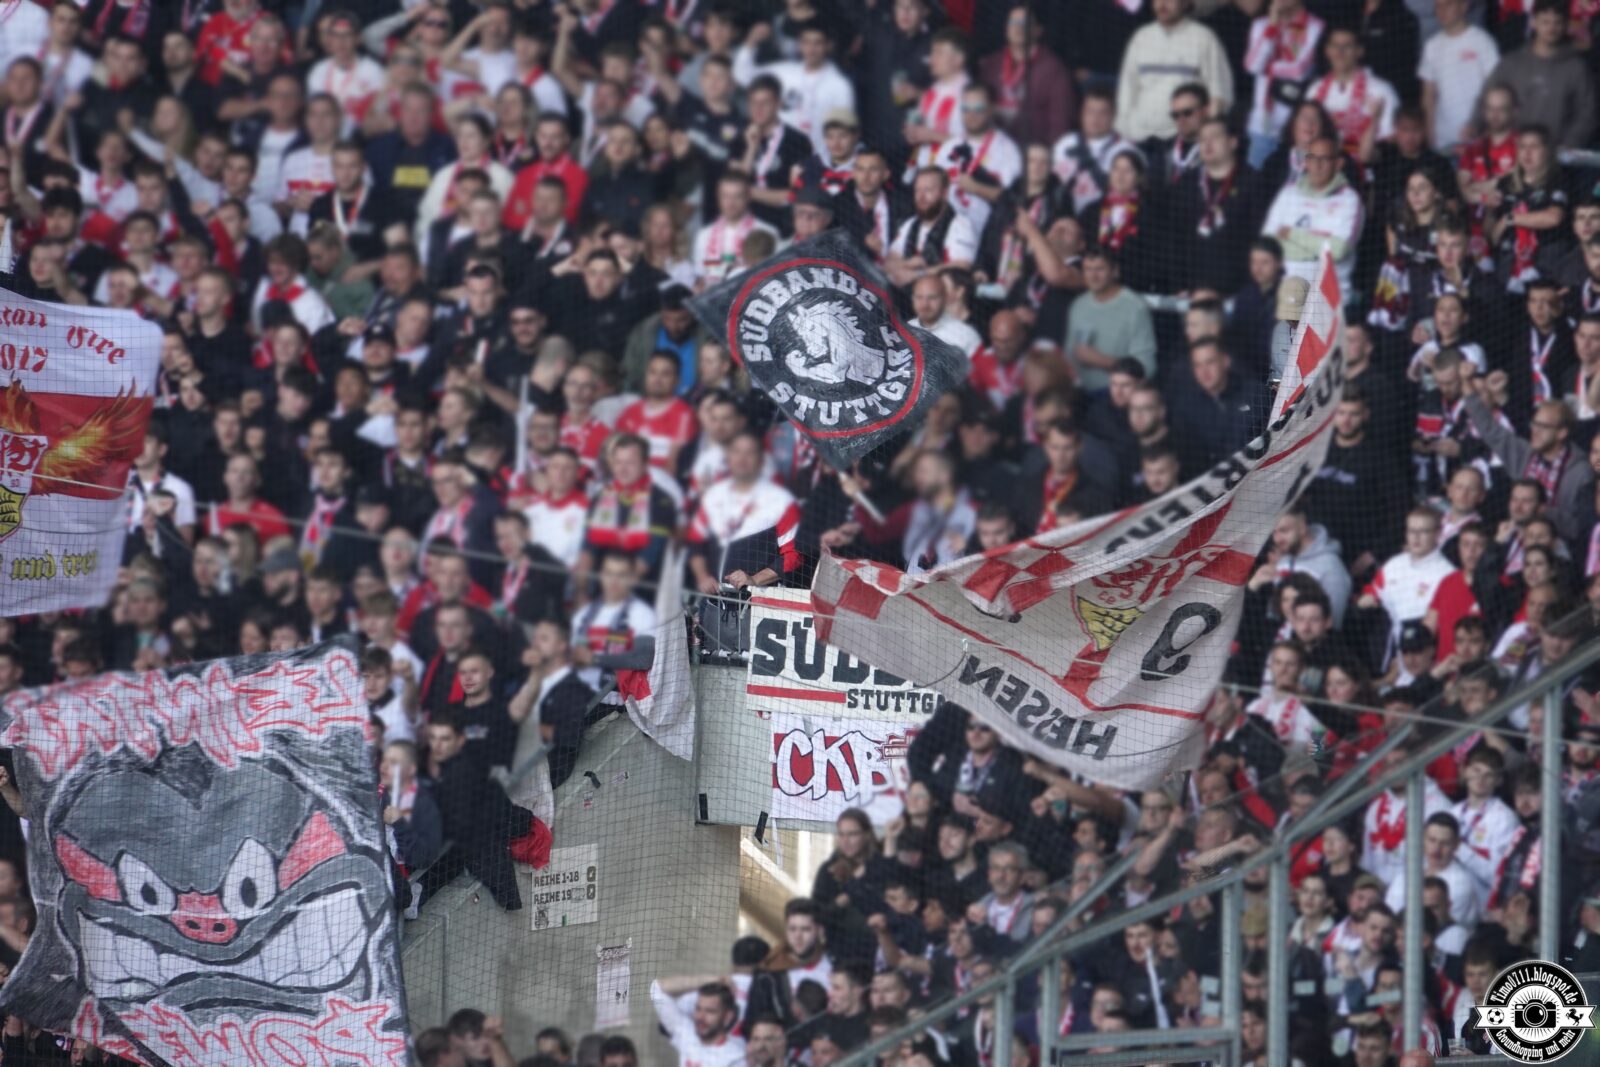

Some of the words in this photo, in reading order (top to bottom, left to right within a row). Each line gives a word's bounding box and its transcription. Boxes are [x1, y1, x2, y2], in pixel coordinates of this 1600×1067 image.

[740, 267, 877, 362] SÜDBANDE
[534, 873, 560, 887] REIHE
[534, 891, 560, 905] REIHE
